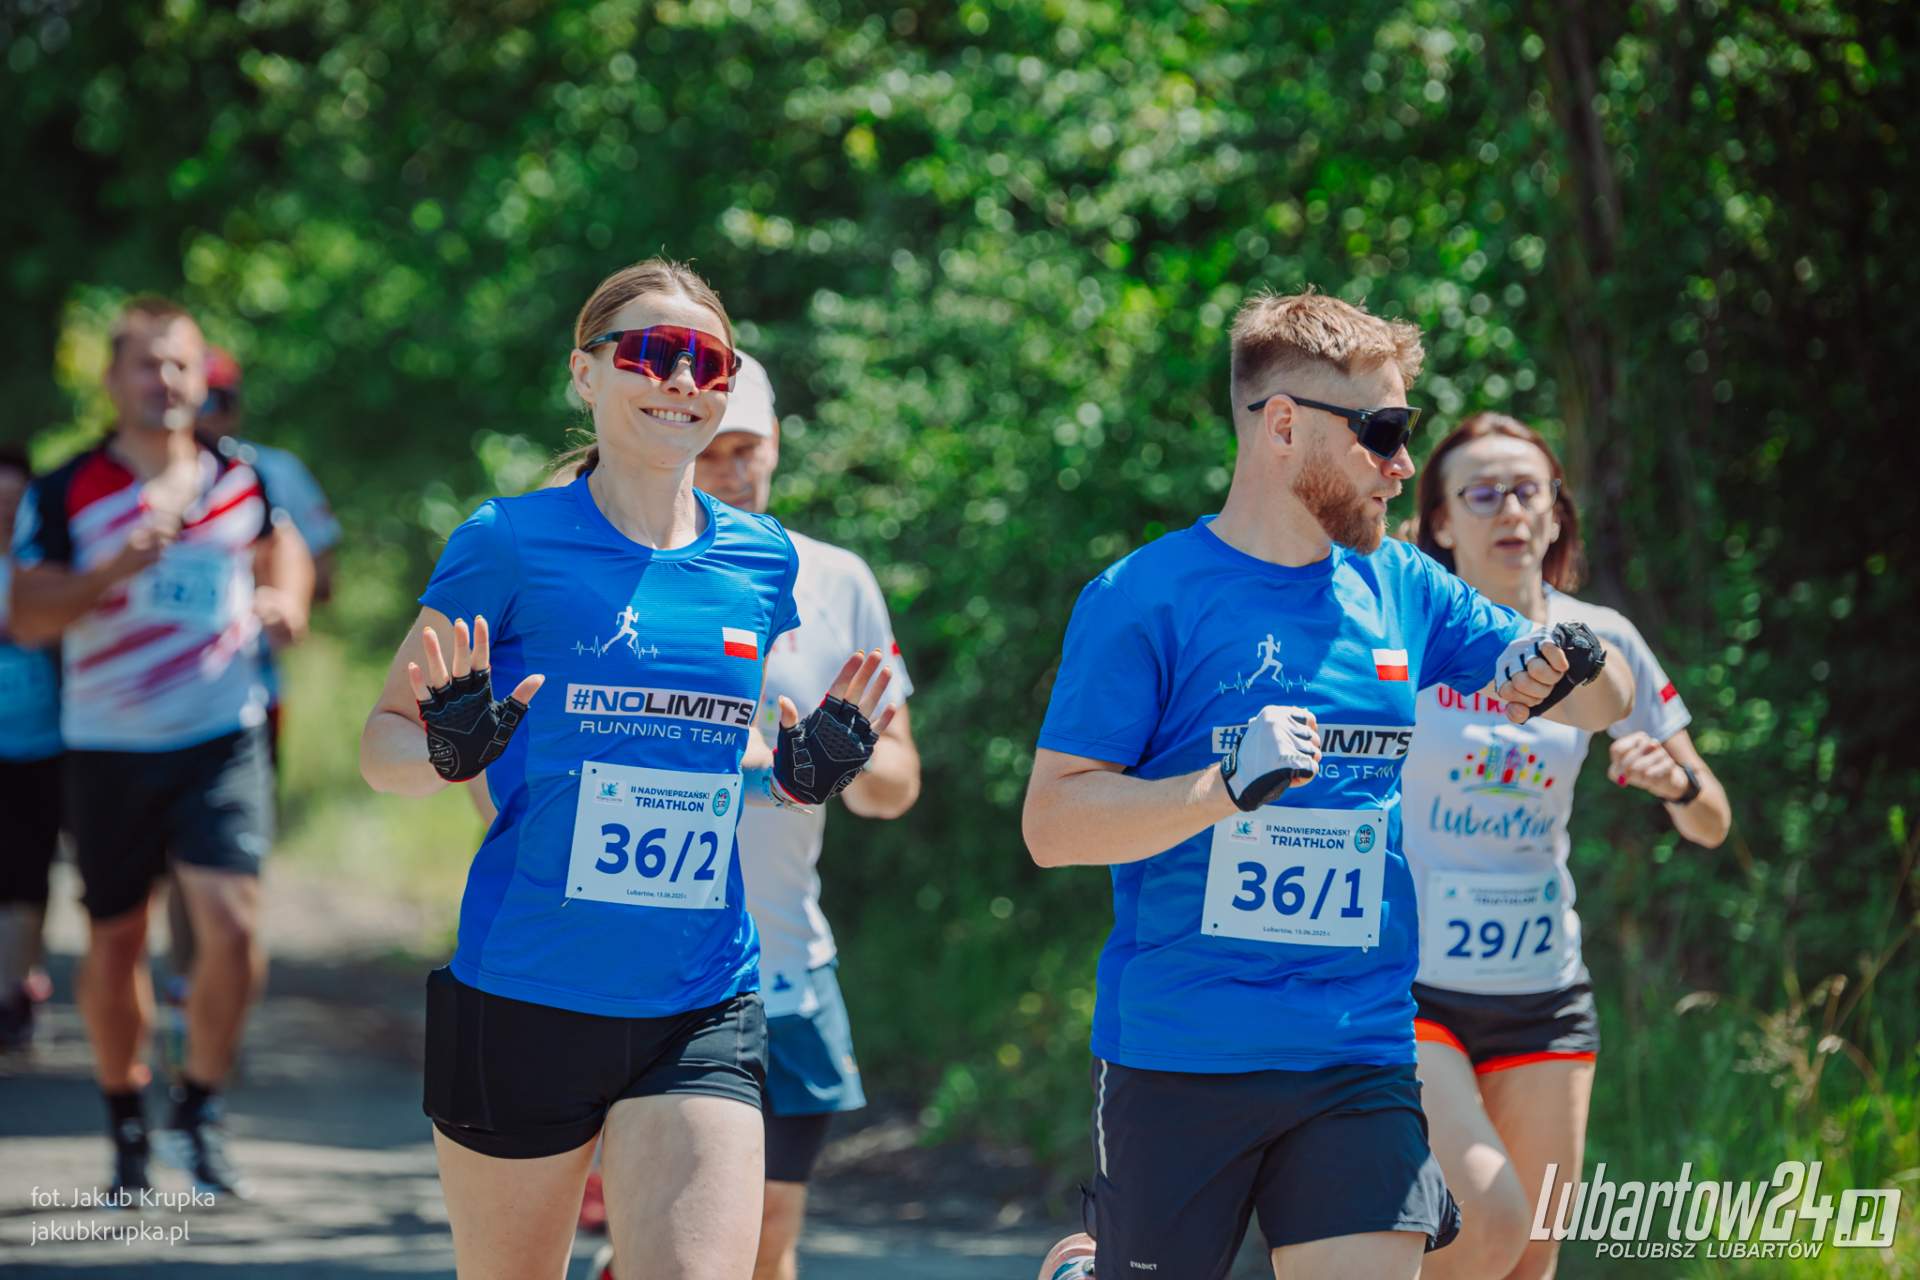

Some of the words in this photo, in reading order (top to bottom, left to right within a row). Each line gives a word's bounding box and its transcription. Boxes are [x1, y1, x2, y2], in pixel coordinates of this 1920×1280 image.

[572, 688, 754, 725] #NOLIMITS
[579, 720, 682, 740] RUNNING
[690, 728, 737, 745] TEAM
[635, 796, 705, 813] TRIATHLON
[595, 823, 718, 883] 36/2
[1270, 834, 1345, 850] TRIATHLON
[1232, 861, 1364, 920] 36/1
[1447, 916, 1553, 960] 29/2
